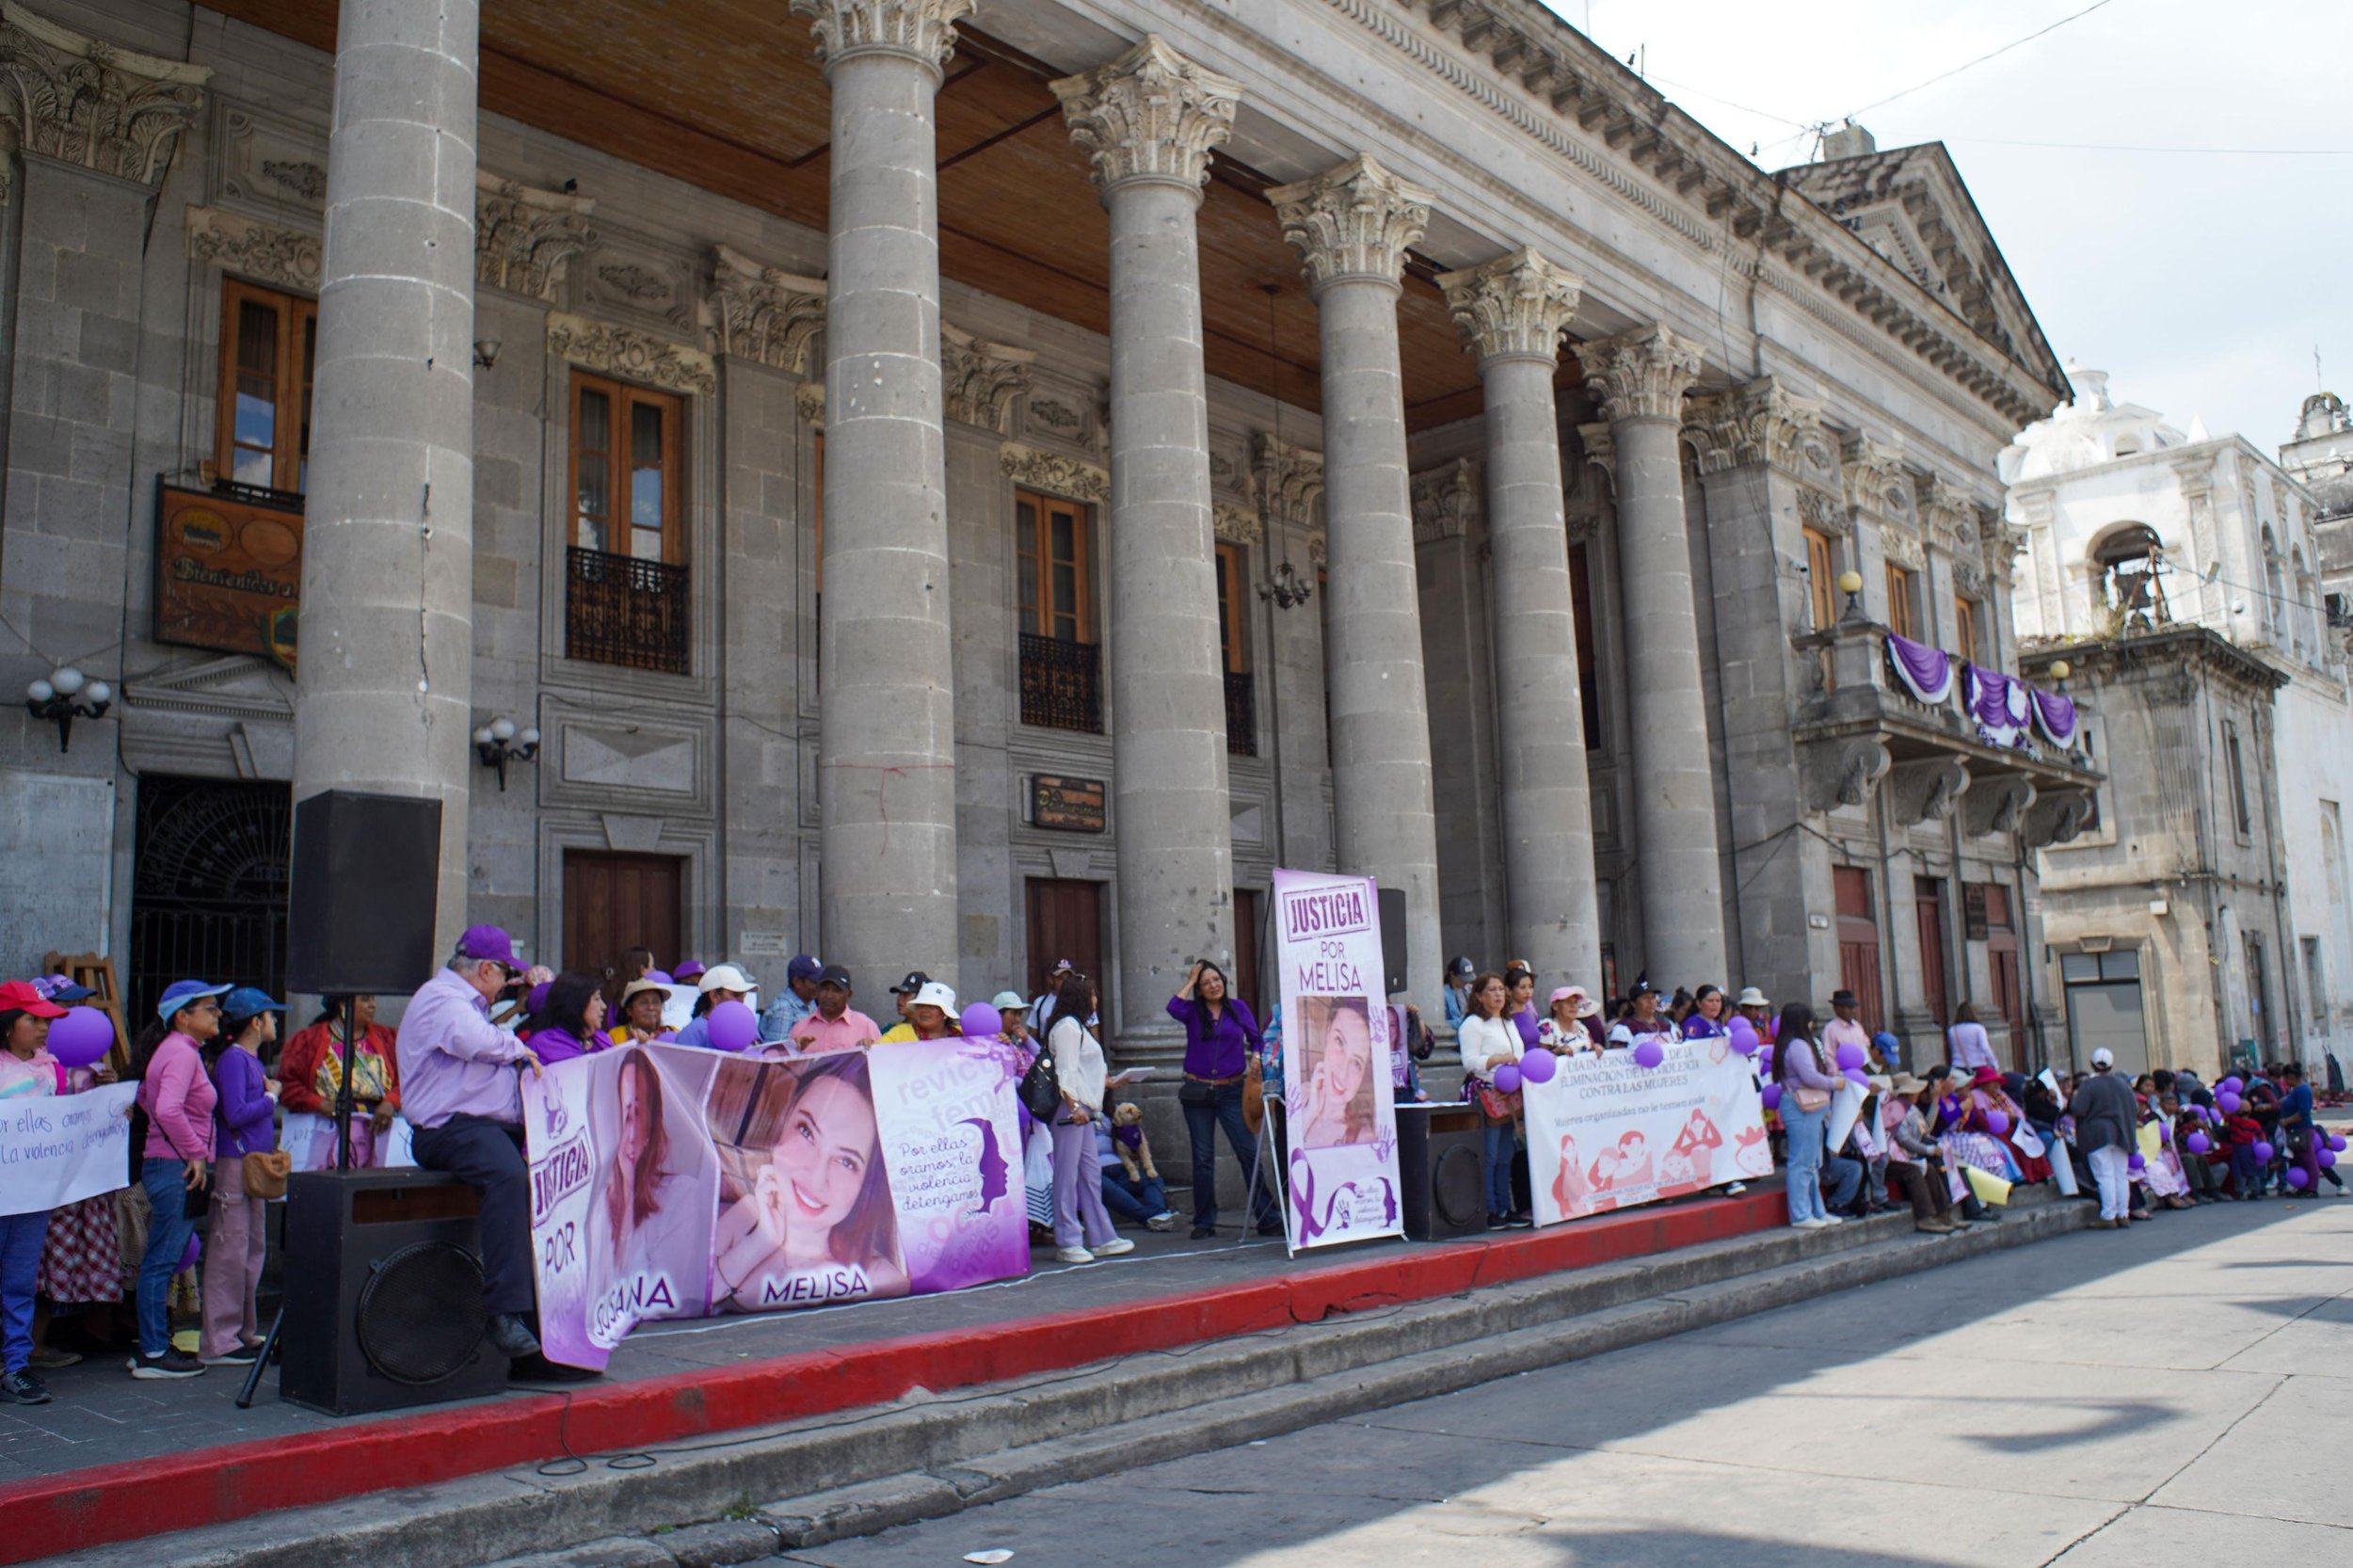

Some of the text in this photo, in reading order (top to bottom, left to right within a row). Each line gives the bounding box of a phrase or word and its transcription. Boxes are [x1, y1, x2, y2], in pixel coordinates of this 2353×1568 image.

[1290, 891, 1364, 934] JUSTICIA
[1321, 941, 1345, 959] POR
[1299, 962, 1362, 992] MELISA
[1579, 1074, 1688, 1099] CONTRA LAS MUJERES
[17, 1107, 53, 1134] ellas
[24, 1140, 74, 1160] violencia
[899, 1136, 968, 1158] Por ellas
[959, 1151, 974, 1165] la
[908, 1175, 971, 1193] violencia
[902, 1188, 979, 1212] detengamos
[544, 1221, 576, 1284] POR
[764, 1271, 868, 1304] MELISA
